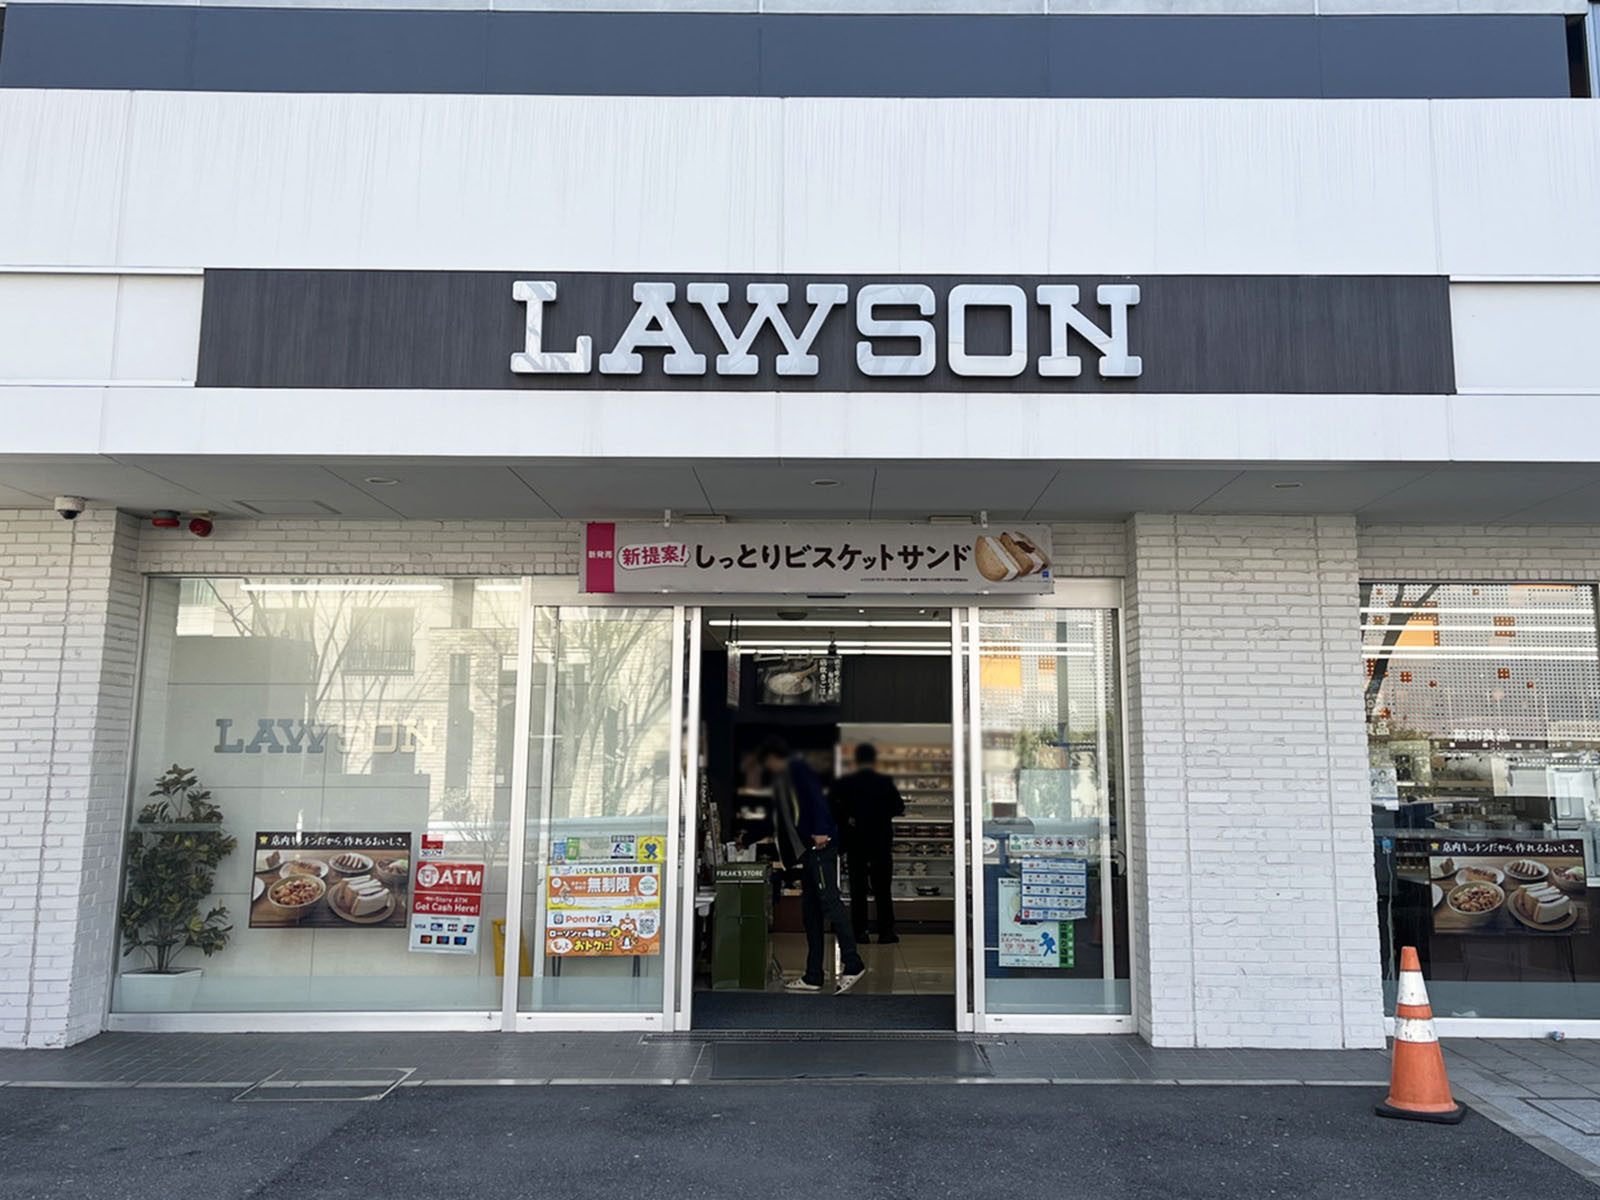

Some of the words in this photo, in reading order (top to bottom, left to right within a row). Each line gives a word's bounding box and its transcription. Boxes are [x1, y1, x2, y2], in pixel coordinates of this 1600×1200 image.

[510, 280, 1142, 376] LAWSON
[622, 544, 687, 566] 新提案!
[695, 543, 972, 571] しっとりビスケットサンド
[214, 718, 437, 753] LAWSON
[439, 869, 482, 886] ATM
[415, 901, 430, 911] Get
[432, 902, 453, 912] Cash
[455, 903, 478, 913] Here!
[566, 915, 612, 923] Pontaパス
